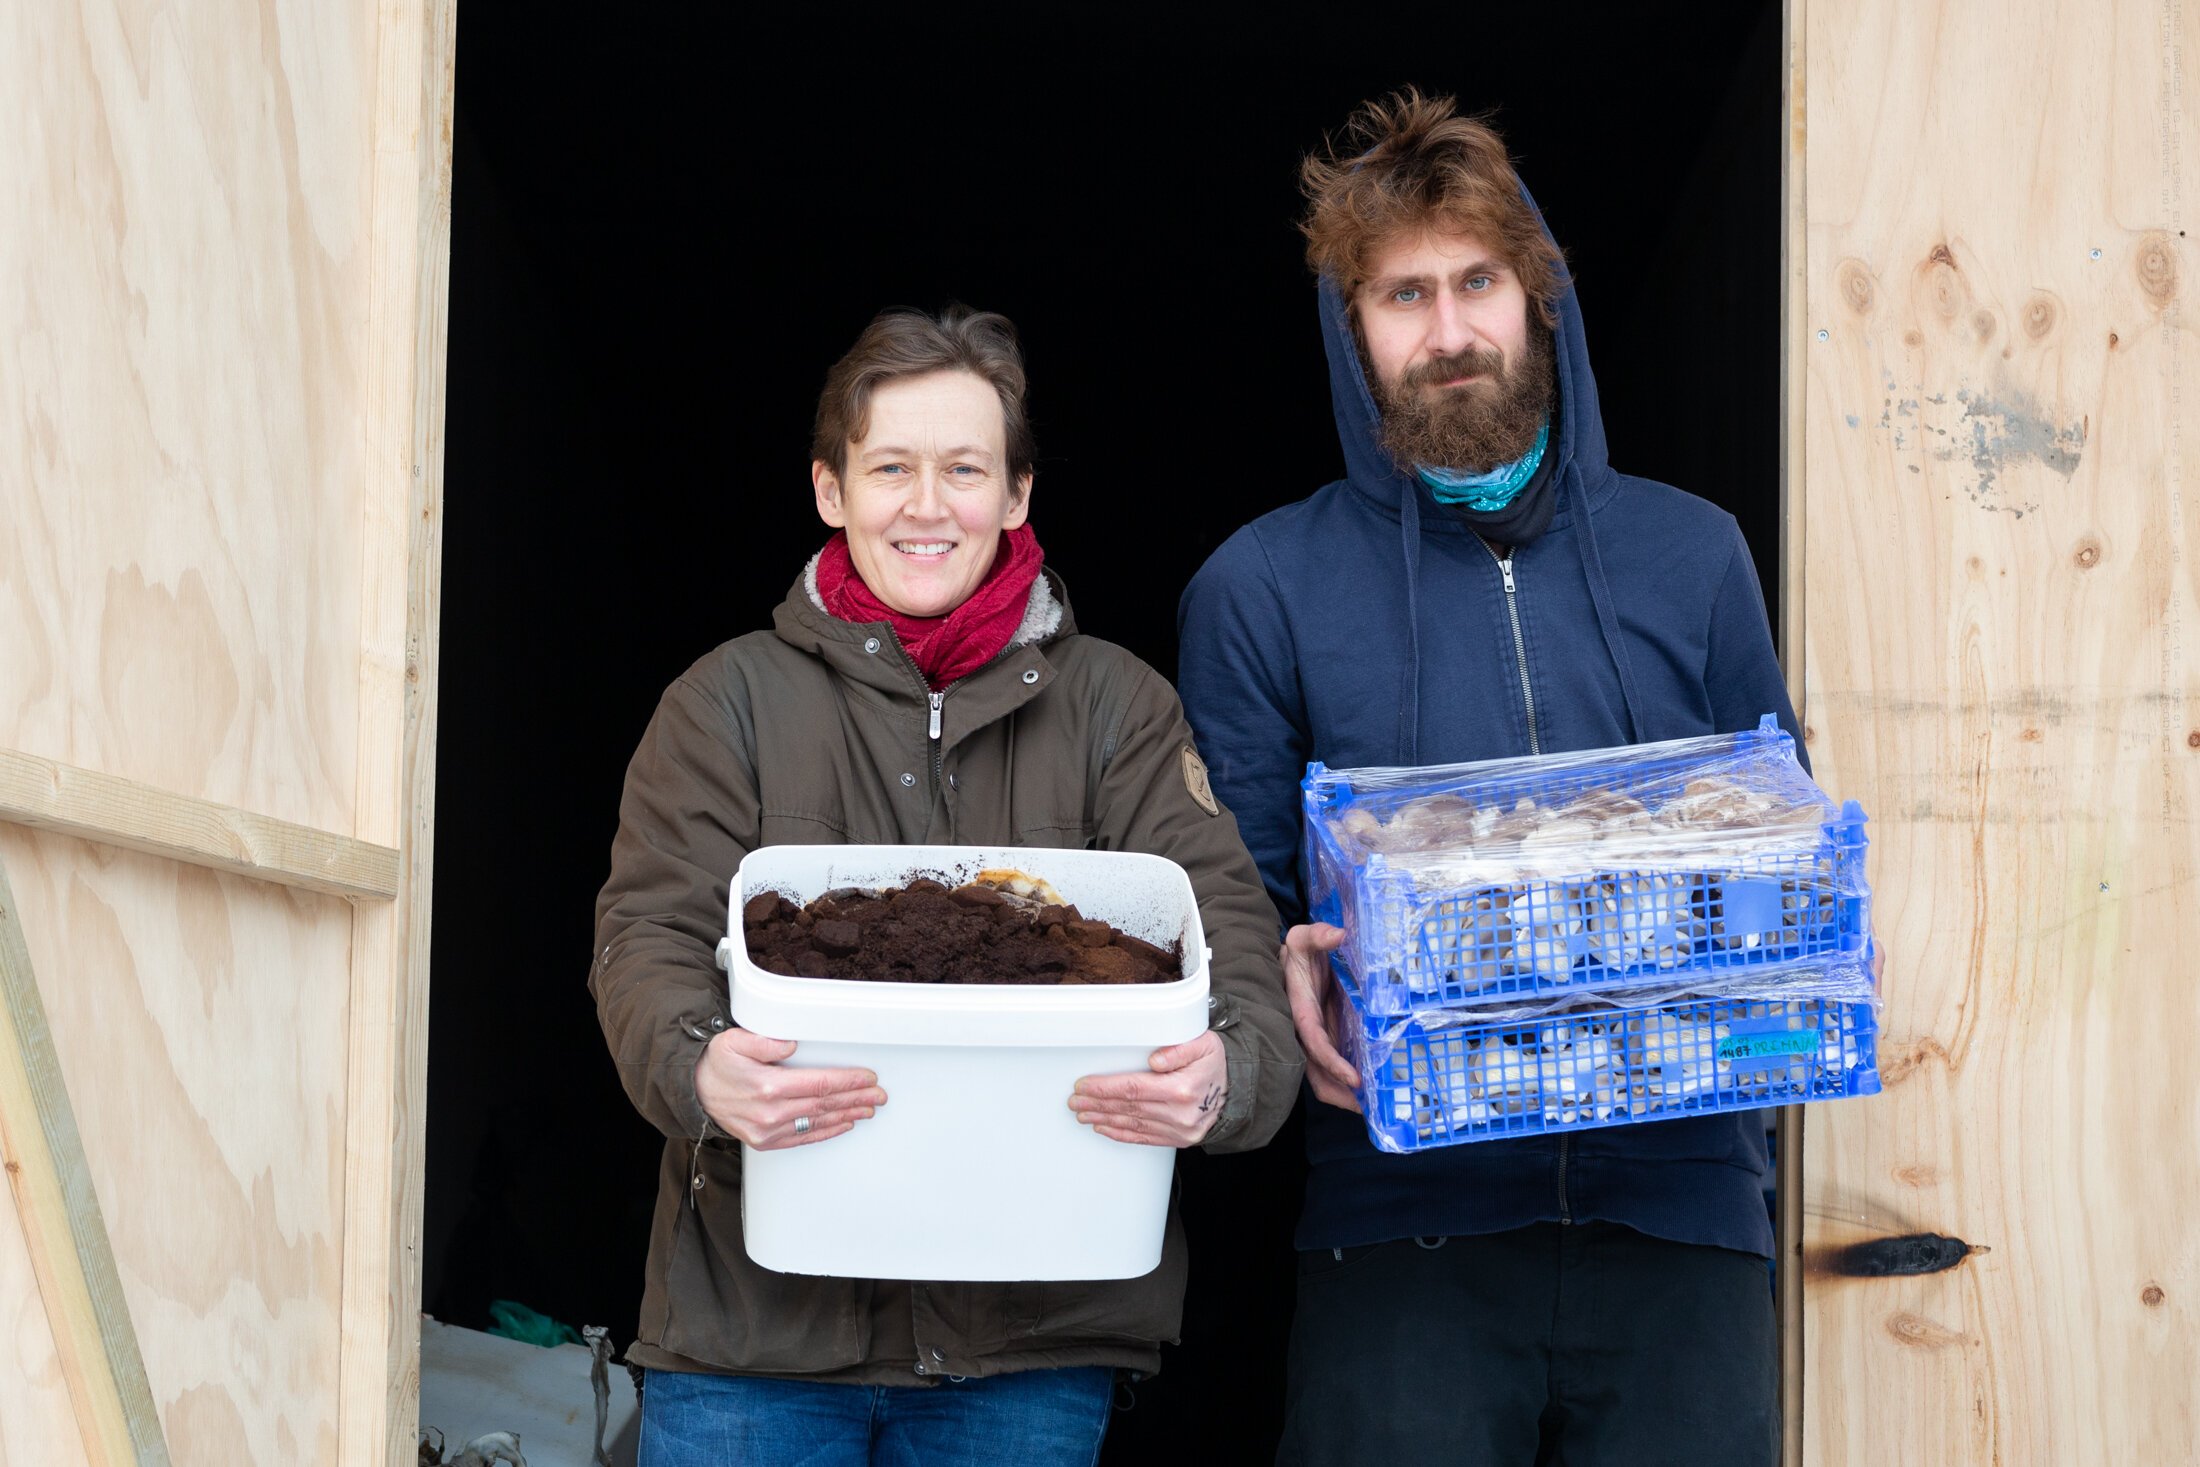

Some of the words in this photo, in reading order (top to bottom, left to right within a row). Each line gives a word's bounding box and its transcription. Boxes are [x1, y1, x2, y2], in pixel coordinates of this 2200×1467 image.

[2161, 55, 2171, 73] OF
[2172, 44, 2182, 97] ARAUCO
[2161, 79, 2171, 179] PERFORMANCE
[2172, 385, 2182, 405] EN
[1720, 1045, 1752, 1058] 1487
